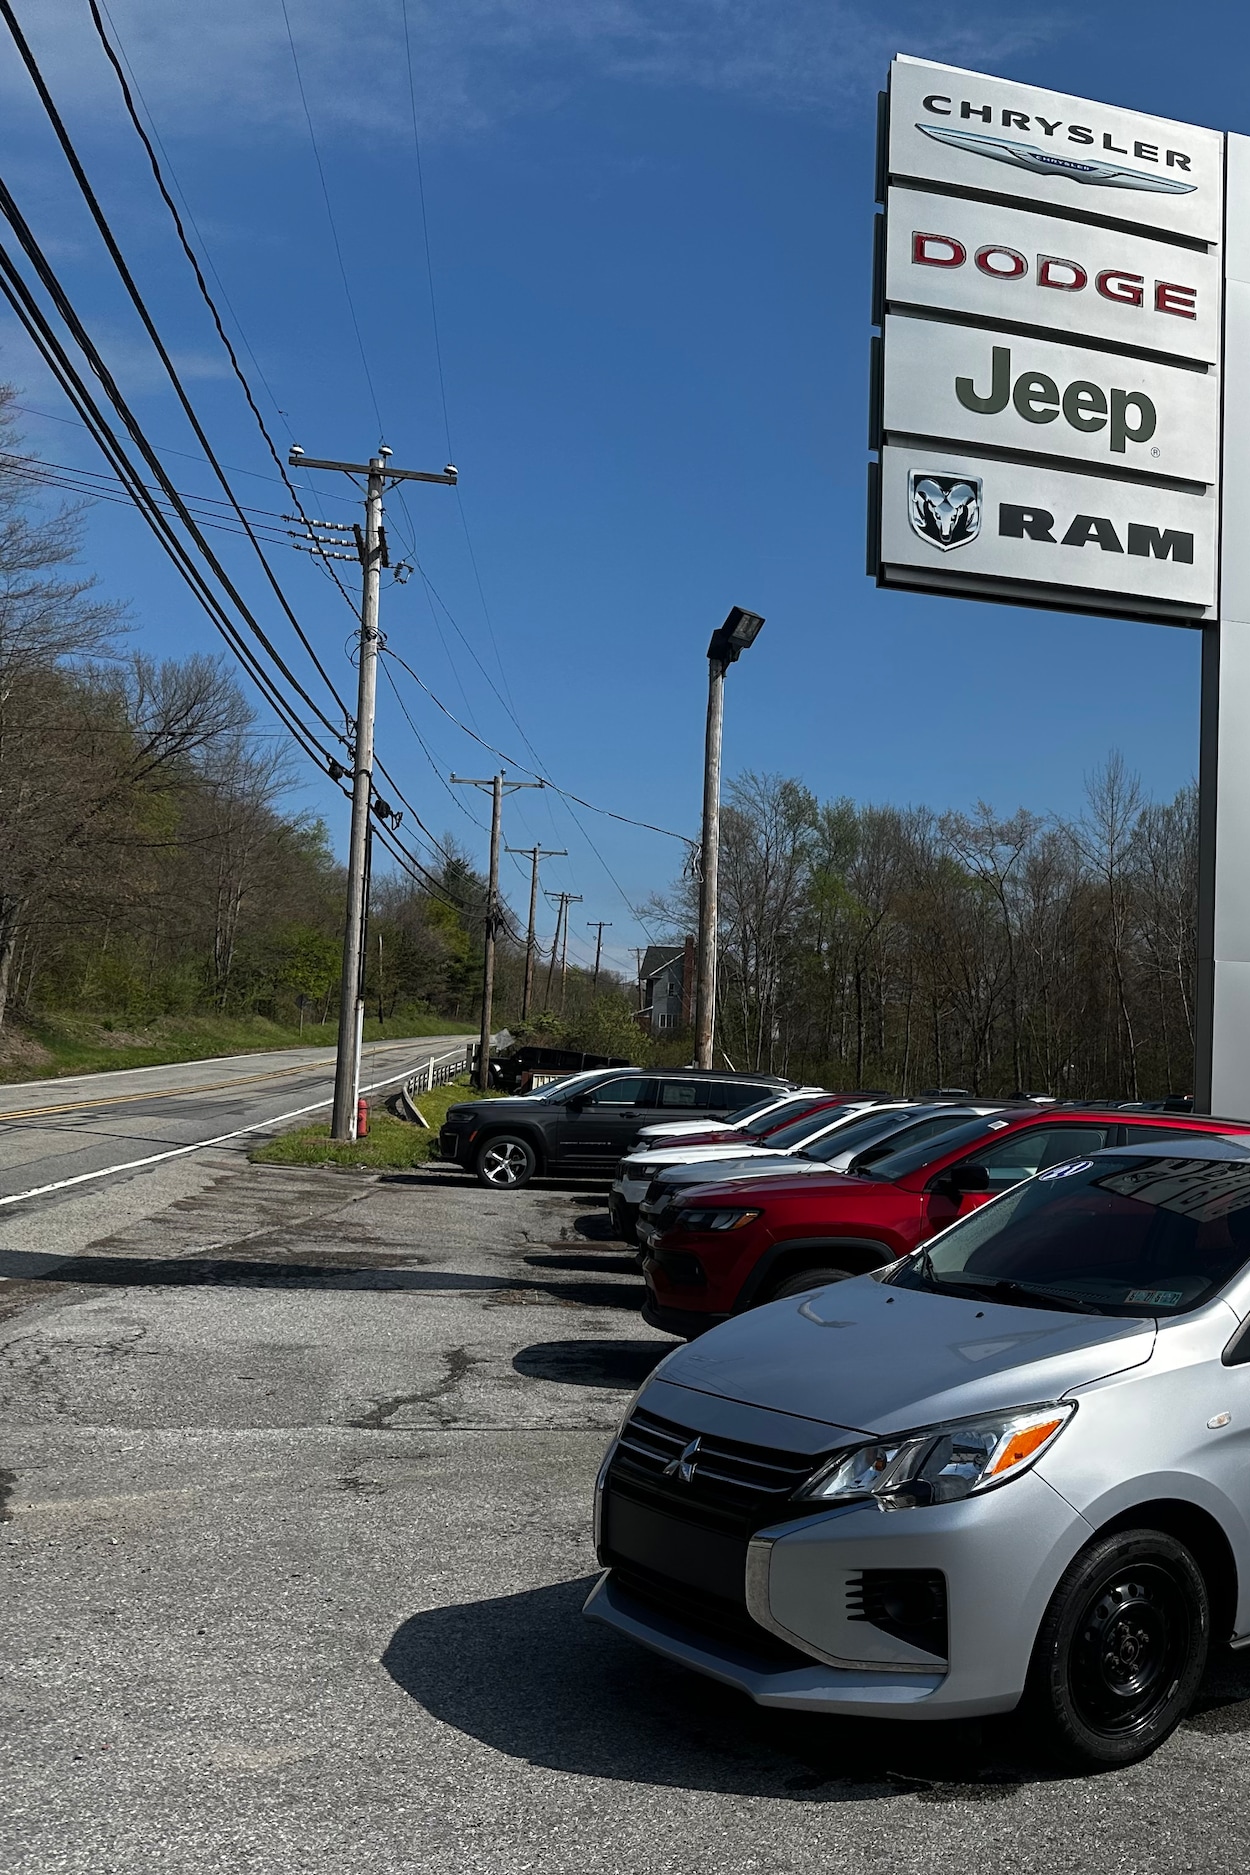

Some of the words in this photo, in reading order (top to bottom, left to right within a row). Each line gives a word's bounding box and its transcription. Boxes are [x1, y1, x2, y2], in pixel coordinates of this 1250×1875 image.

[922, 95, 1192, 172] CHRYSLER
[912, 230, 1198, 320] DODGE
[955, 345, 1157, 454] Jeep
[998, 502, 1194, 565] RAM
